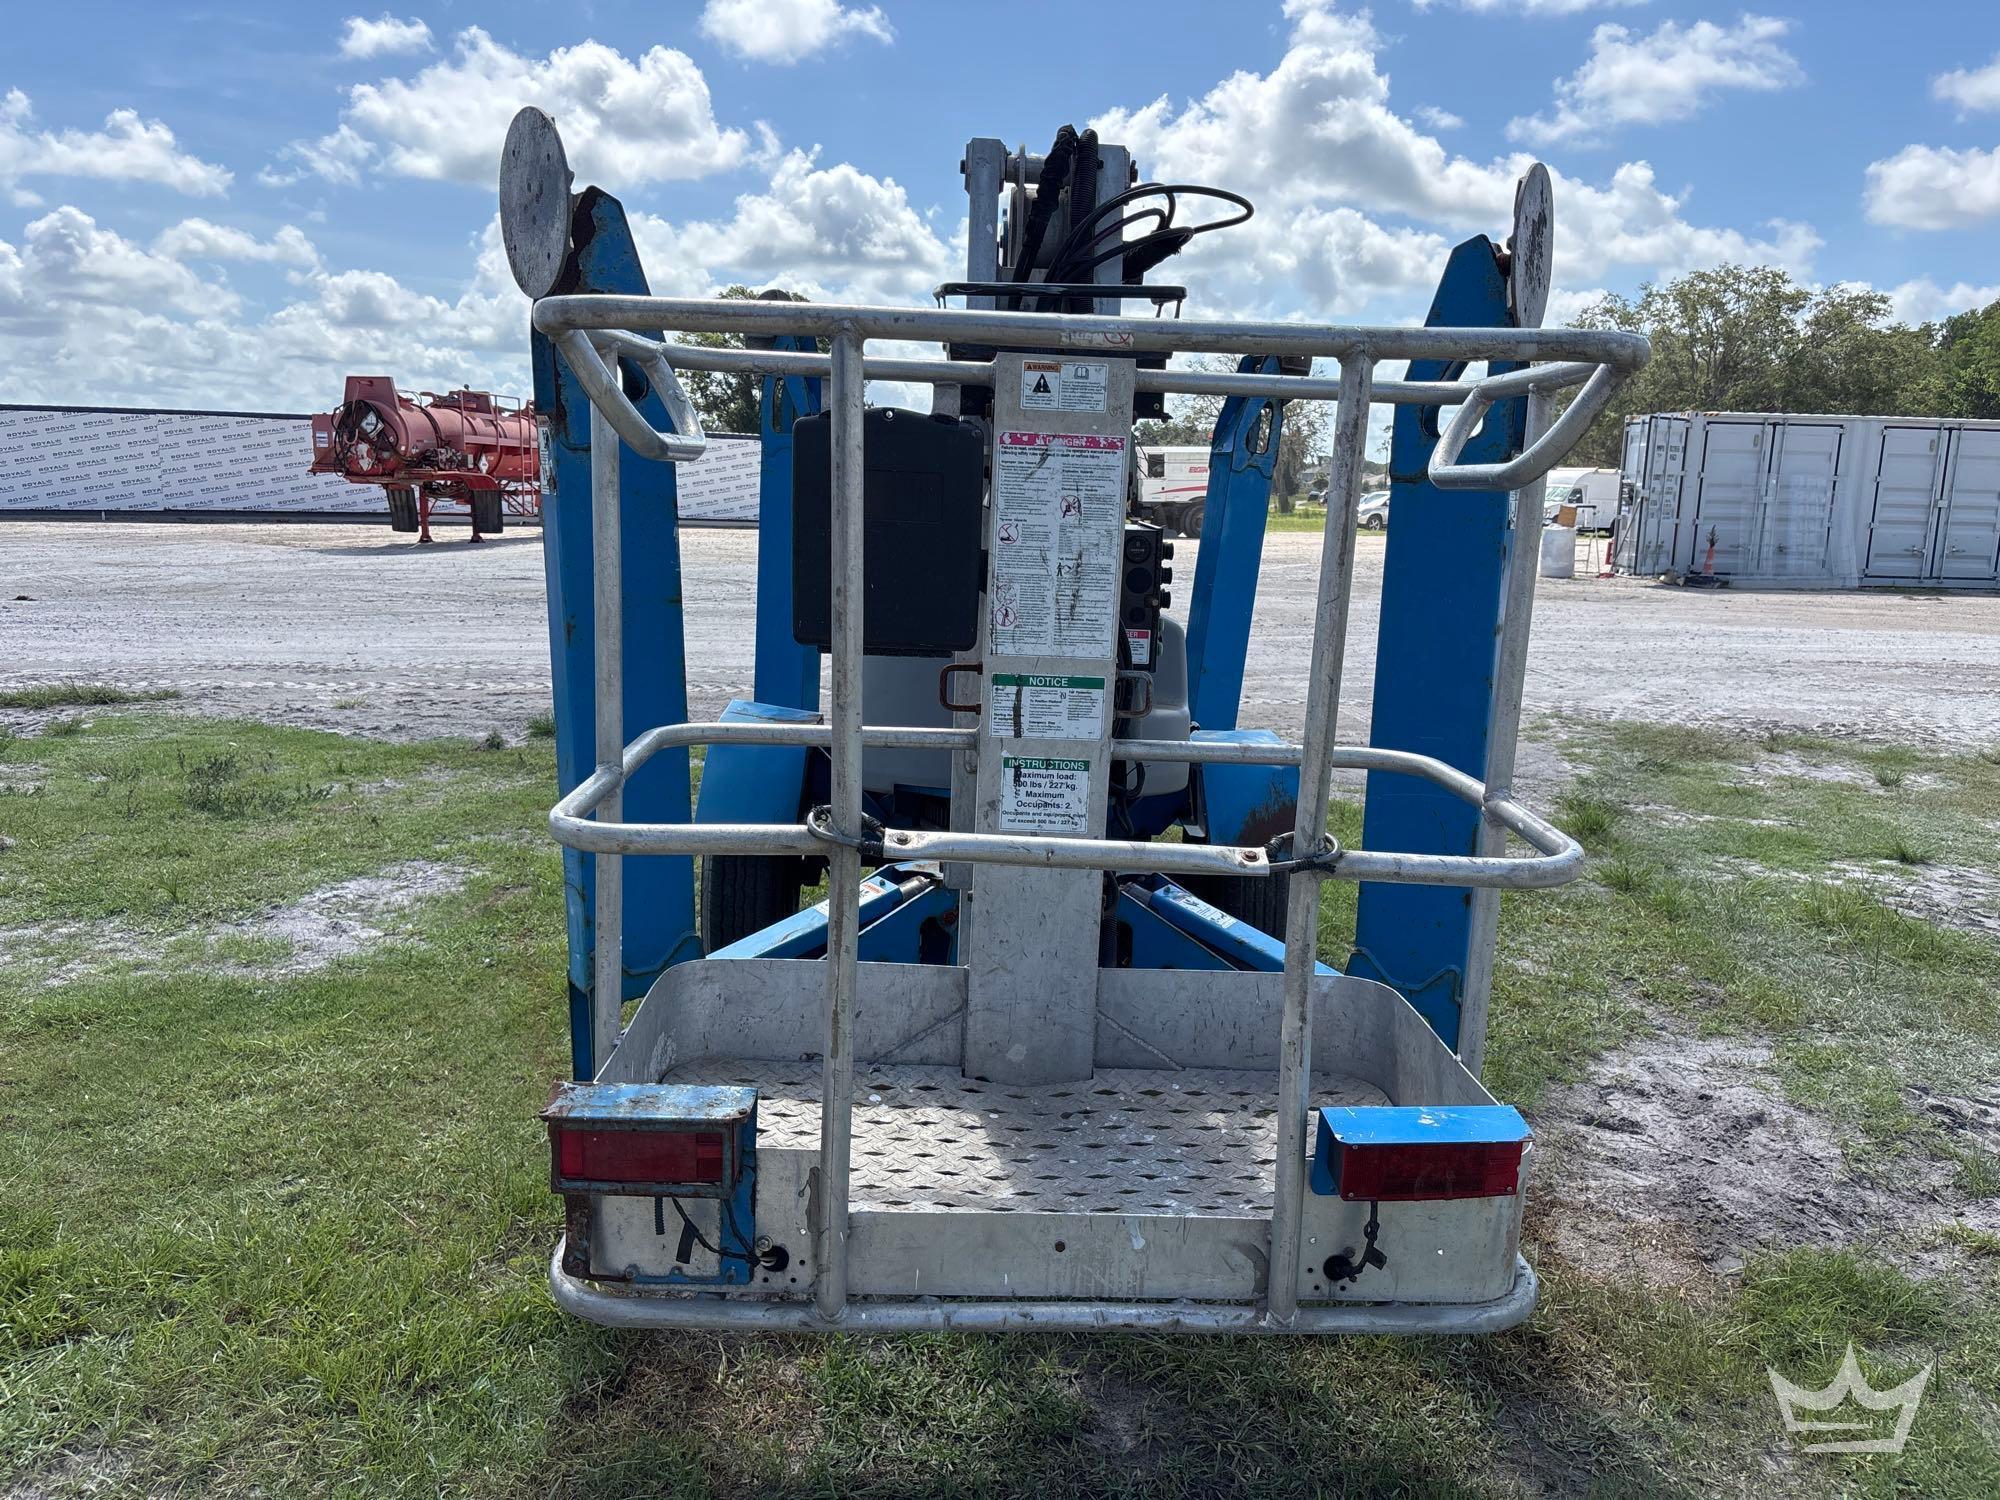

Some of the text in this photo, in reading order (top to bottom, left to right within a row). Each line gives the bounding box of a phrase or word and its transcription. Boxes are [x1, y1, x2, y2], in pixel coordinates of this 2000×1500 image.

[1046, 437, 1084, 446] DNGER
[1029, 677, 1068, 686] NOTICE
[1009, 760, 1084, 769] INSTRUCTIONS
[1066, 783, 1078, 791] kg.
[1016, 800, 1063, 809] Occupants:
